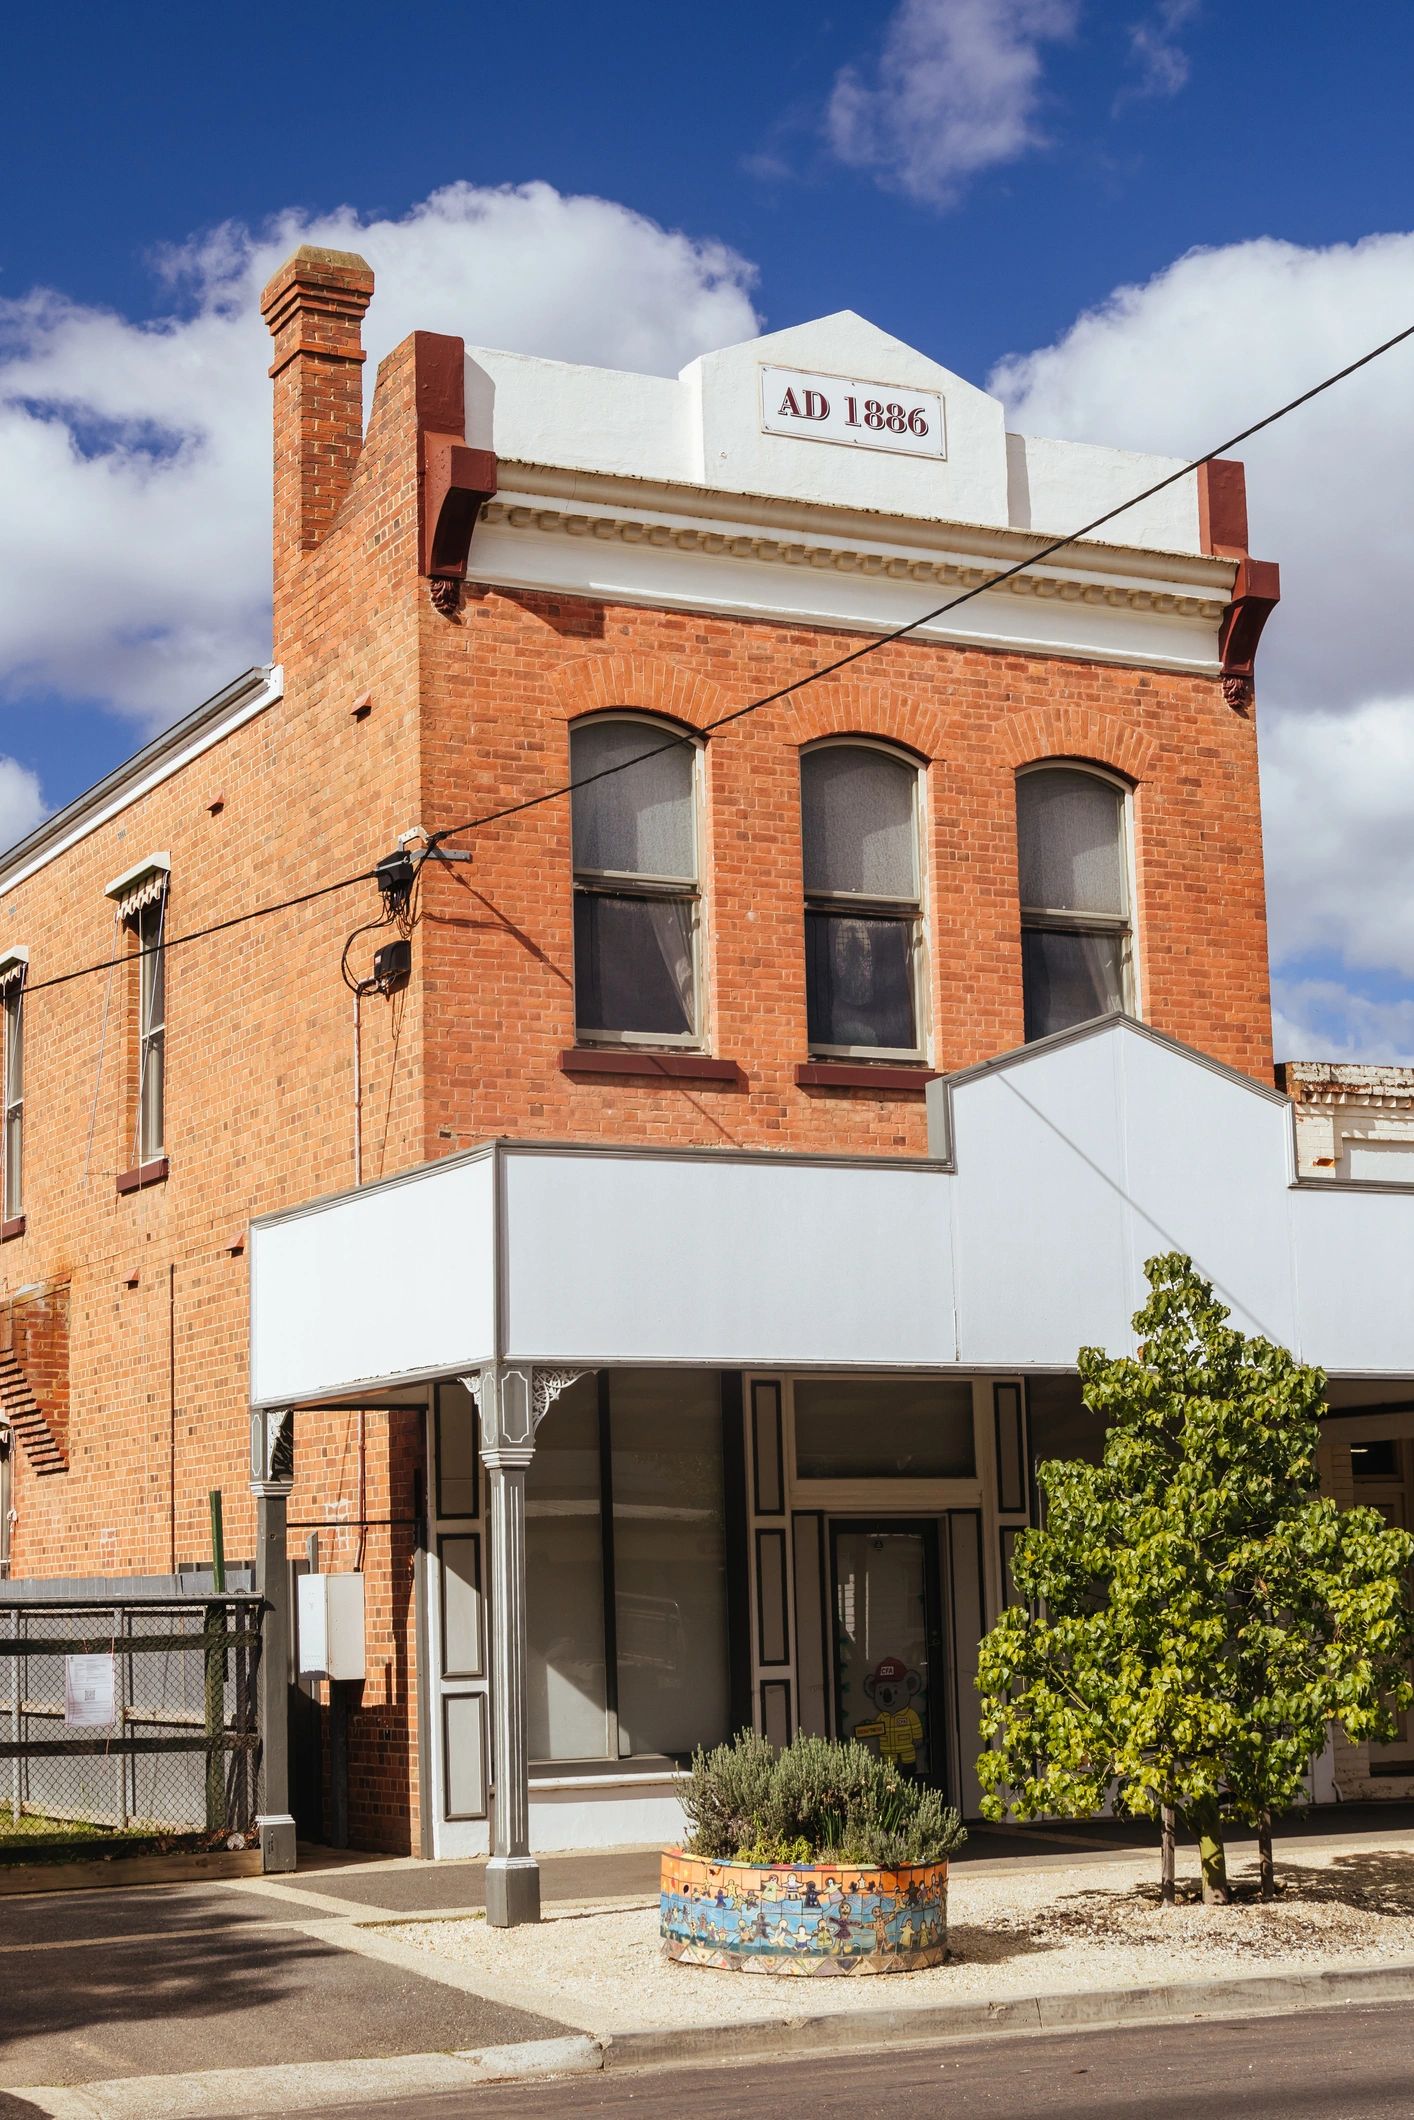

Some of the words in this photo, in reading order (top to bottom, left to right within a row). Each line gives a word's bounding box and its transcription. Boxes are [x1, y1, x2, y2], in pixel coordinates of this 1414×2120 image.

[778, 387, 830, 420] AD
[844, 396, 928, 436] 1886
[881, 1667, 893, 1675] CFA
